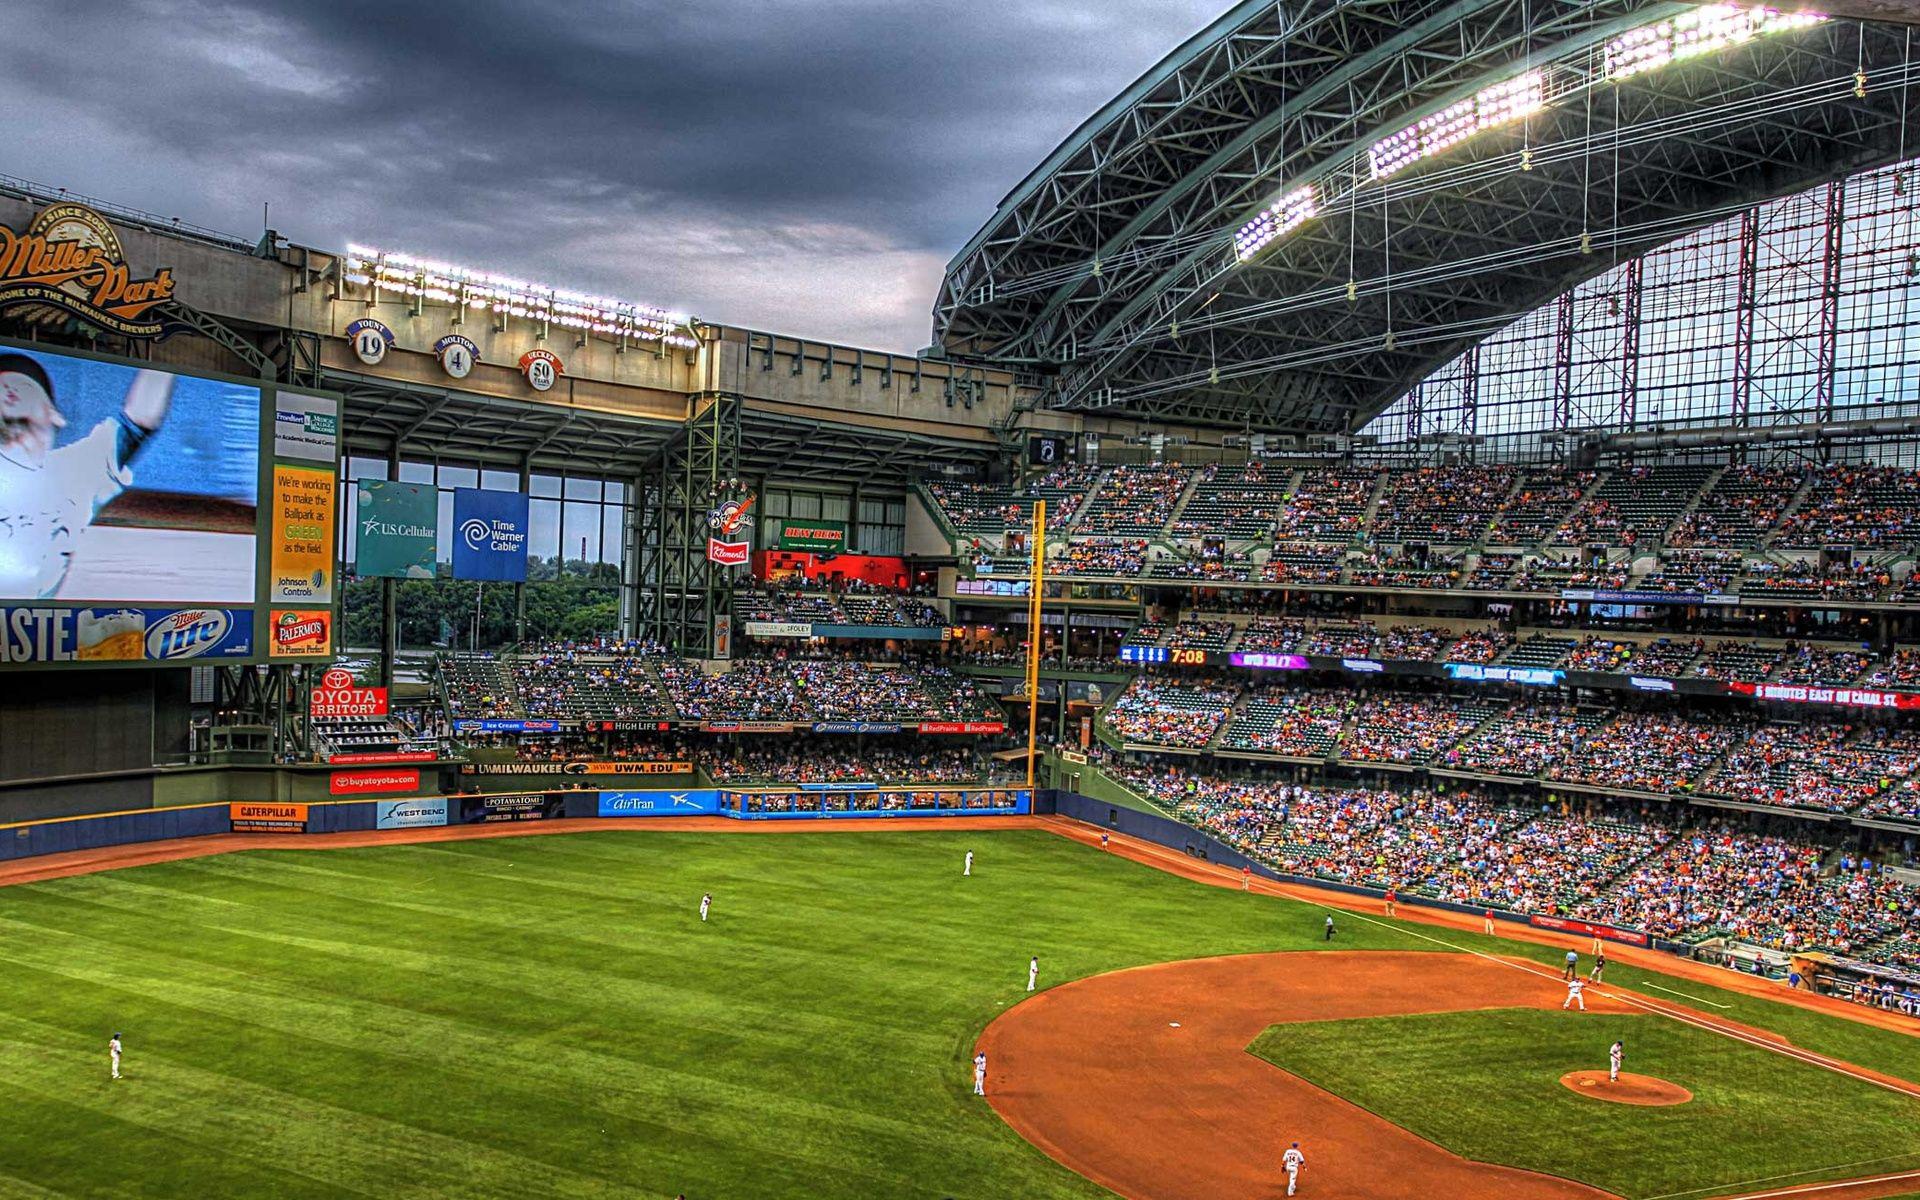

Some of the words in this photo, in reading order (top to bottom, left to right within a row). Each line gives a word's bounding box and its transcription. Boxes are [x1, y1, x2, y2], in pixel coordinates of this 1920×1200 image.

[46, 208, 82, 222] SINCE
[85, 213, 109, 238] 2001
[0, 225, 105, 278] Miller
[81, 257, 174, 307] Park
[27, 288, 41, 297] OF
[43, 289, 63, 301] THE
[65, 296, 118, 328] MILWAUKEE
[120, 323, 162, 334] BREWERS
[357, 319, 384, 332] YOUNT
[360, 335, 381, 357] 19
[441, 336, 474, 351] MOLITOR
[451, 352, 462, 370] 4
[534, 363, 550, 379] 50
[278, 476, 299, 488] We're
[302, 480, 331, 494] working
[282, 493, 290, 503] to
[293, 493, 313, 505] make
[315, 495, 327, 506] the
[284, 507, 314, 521] Ballpark
[316, 512, 324, 521] as
[284, 524, 323, 541] GREEN
[399, 525, 435, 538] Cellular
[491, 519, 515, 532] Time
[491, 530, 525, 542] Warner
[284, 544, 293, 553] as
[294, 542, 305, 553] the
[490, 541, 517, 552] Cable
[278, 577, 307, 587] Johnson
[282, 587, 312, 597] Controls
[170, 611, 206, 629] Miller
[279, 621, 321, 641] PALERMO'S
[159, 619, 220, 659] Lite
[1172, 649, 1205, 664] 7:08
[311, 690, 384, 704] OYOTA.
[1764, 686, 1807, 700] MINUTES
[1808, 689, 1834, 702] EAST
[1851, 691, 1881, 706] CANAL
[310, 704, 376, 714] ERRITORY
[615, 722, 638, 731] HIGH
[639, 723, 657, 731] LIFE
[615, 764, 673, 773] UWM.EDU
[349, 776, 415, 787] buyatoyota.com
[489, 797, 540, 806] POTAWATOMI
[241, 807, 297, 818] CATERPILLAR
[396, 809, 420, 817] WEST
[421, 808, 445, 816] BEND
